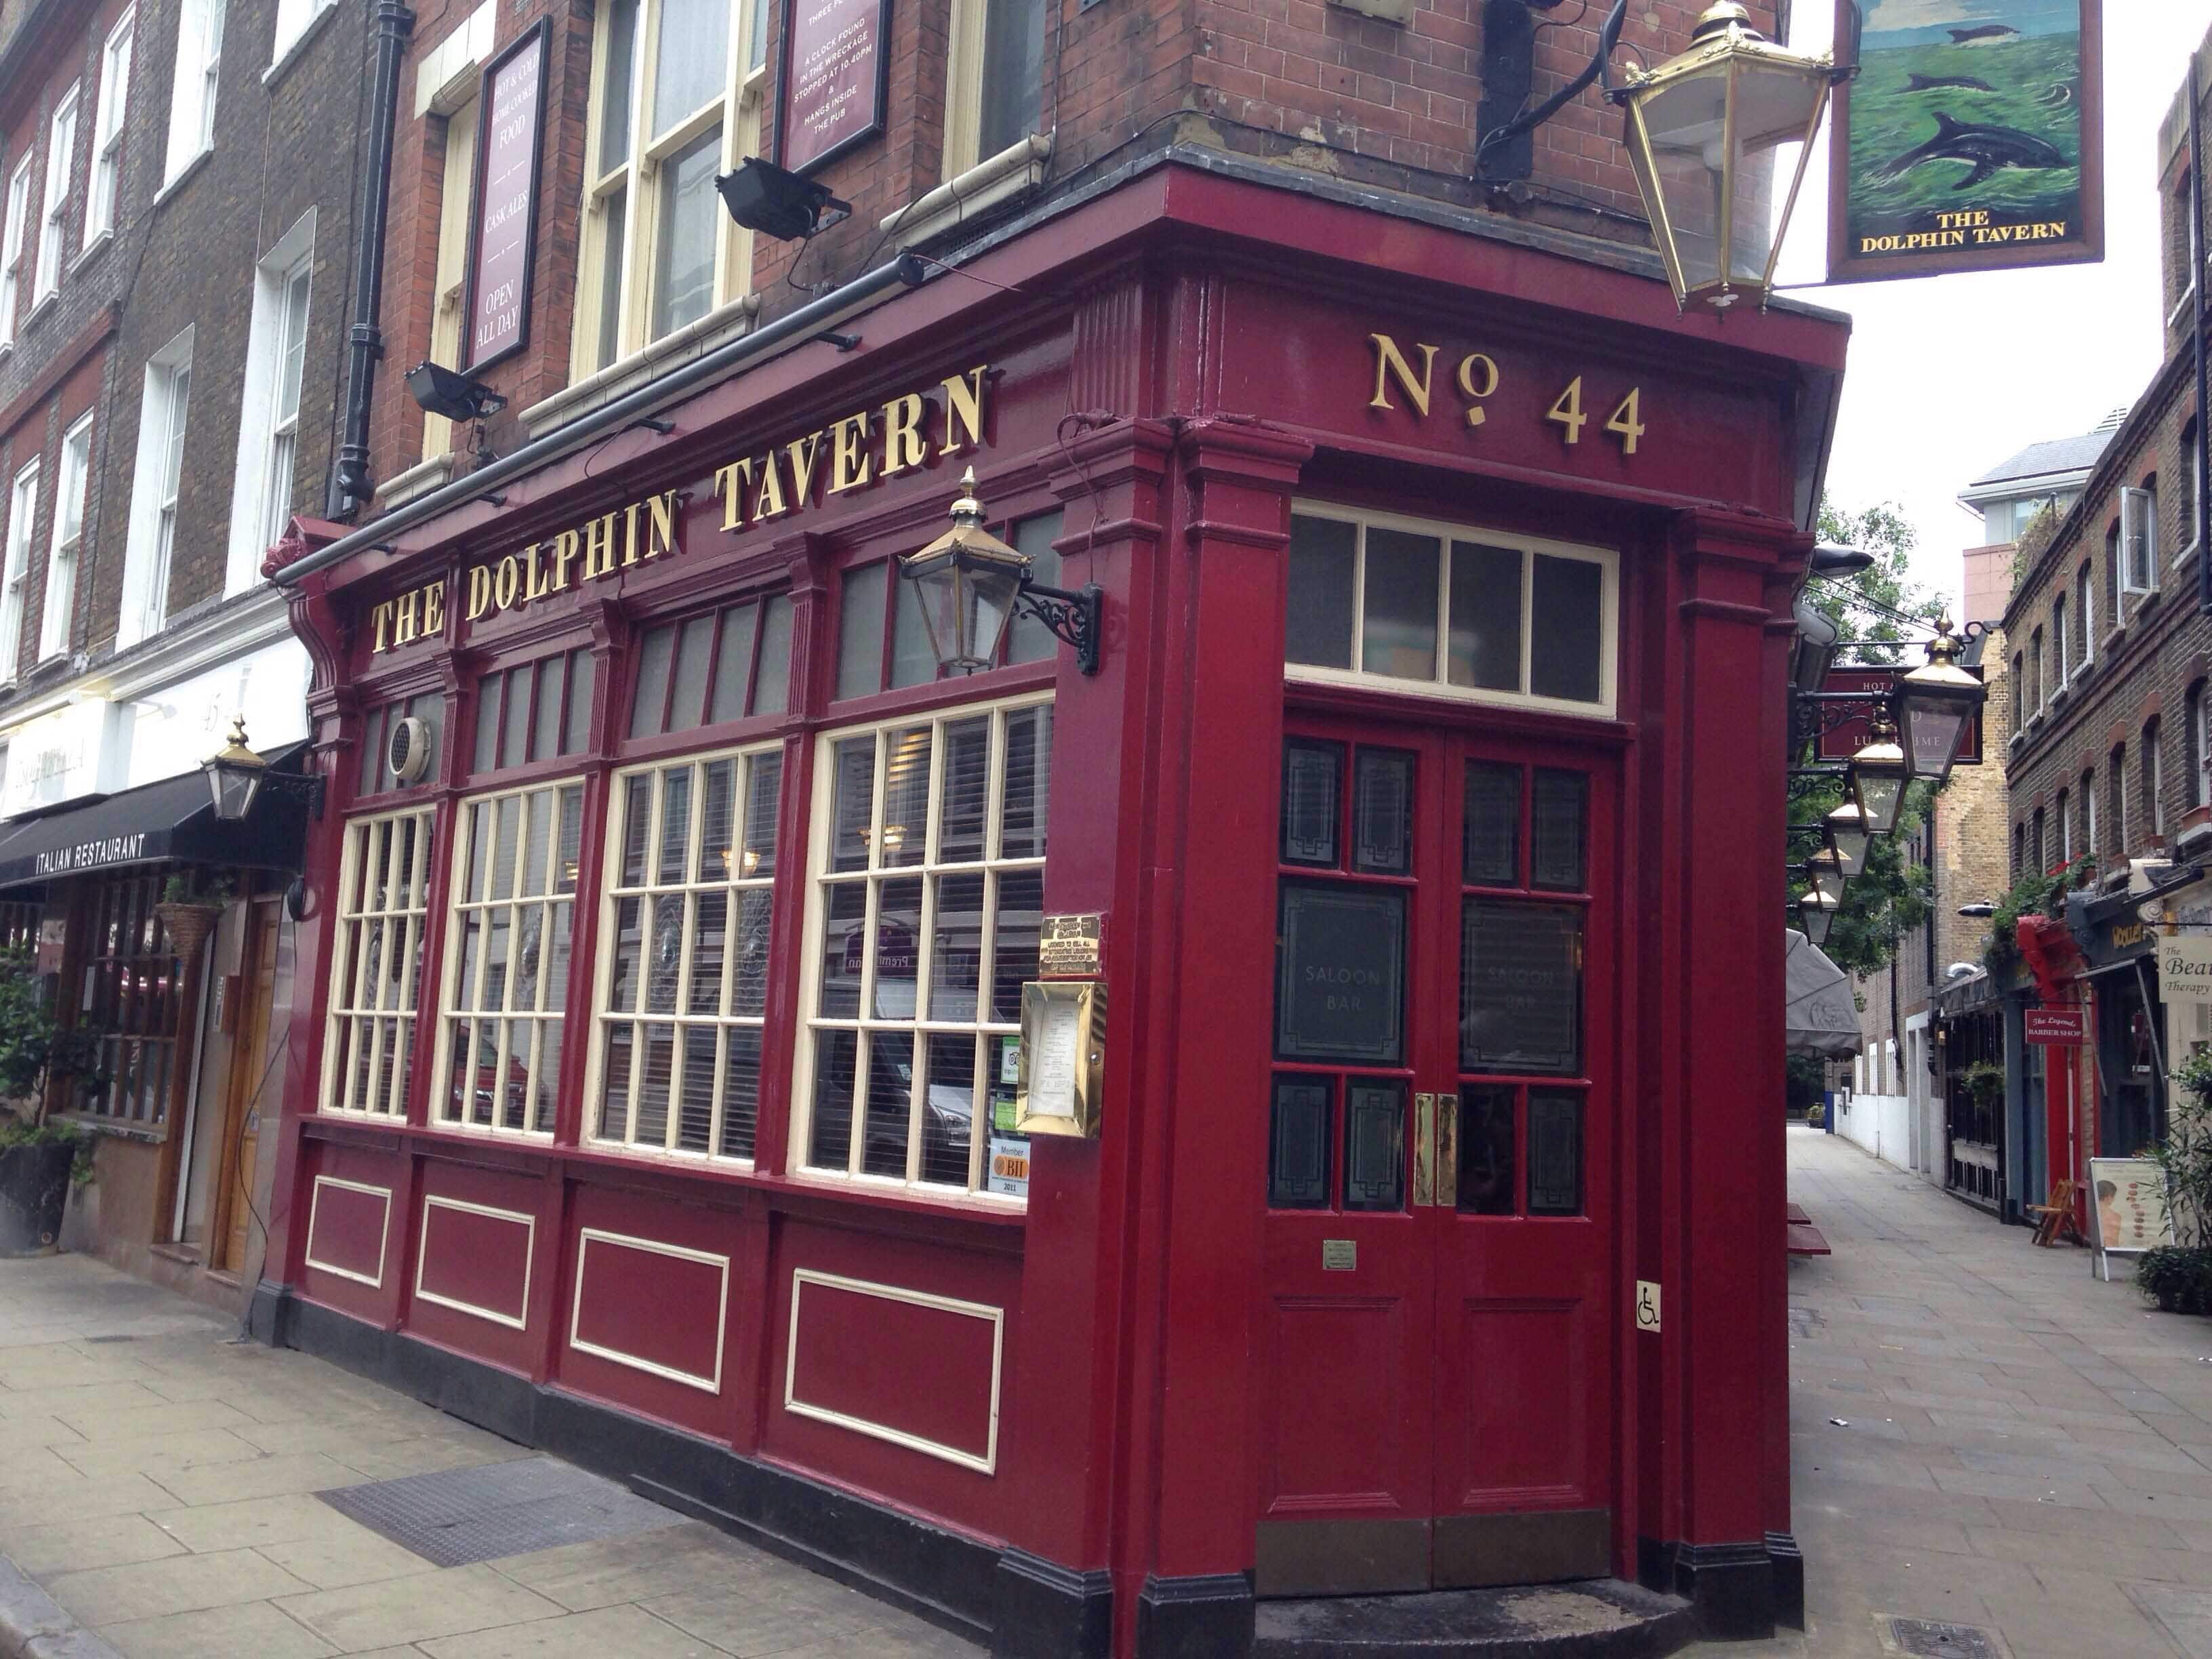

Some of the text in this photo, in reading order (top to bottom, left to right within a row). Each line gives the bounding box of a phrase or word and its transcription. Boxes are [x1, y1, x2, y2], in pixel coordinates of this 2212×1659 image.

[809, 3, 833, 26] THREE
[800, 30, 867, 85] IN THE WRECKAGE
[805, 18, 865, 66] A CLOCK FOUND
[495, 77, 510, 102] HOT
[519, 53, 539, 80] COLD
[794, 44, 872, 102] STOPPED AT 10.40PM
[492, 79, 537, 126] HOME COOKED
[804, 85, 857, 125] HANGS INSIDE
[499, 115, 525, 149] FOOD
[814, 108, 846, 135] THE PUB
[485, 190, 528, 233] CASK ALES
[1937, 211, 1988, 229] THE
[1860, 222, 2066, 253] DOLPHIN TAVERN
[486, 279, 514, 314] OPEN
[476, 305, 518, 348] ALL DAY
[1546, 375, 1645, 455] 44
[371, 364, 989, 655] THE DOLPHIN TAVERN
[36, 834, 145, 875] ITALIAN RESTAURANT
[2165, 946, 2181, 956] The
[1305, 965, 1381, 987] SALOON
[2165, 981, 2209, 995] Therapy
[1326, 995, 1361, 1011] BAR
[1001, 1145, 1024, 1156] Member
[1004, 1183, 1016, 1191] 2011
